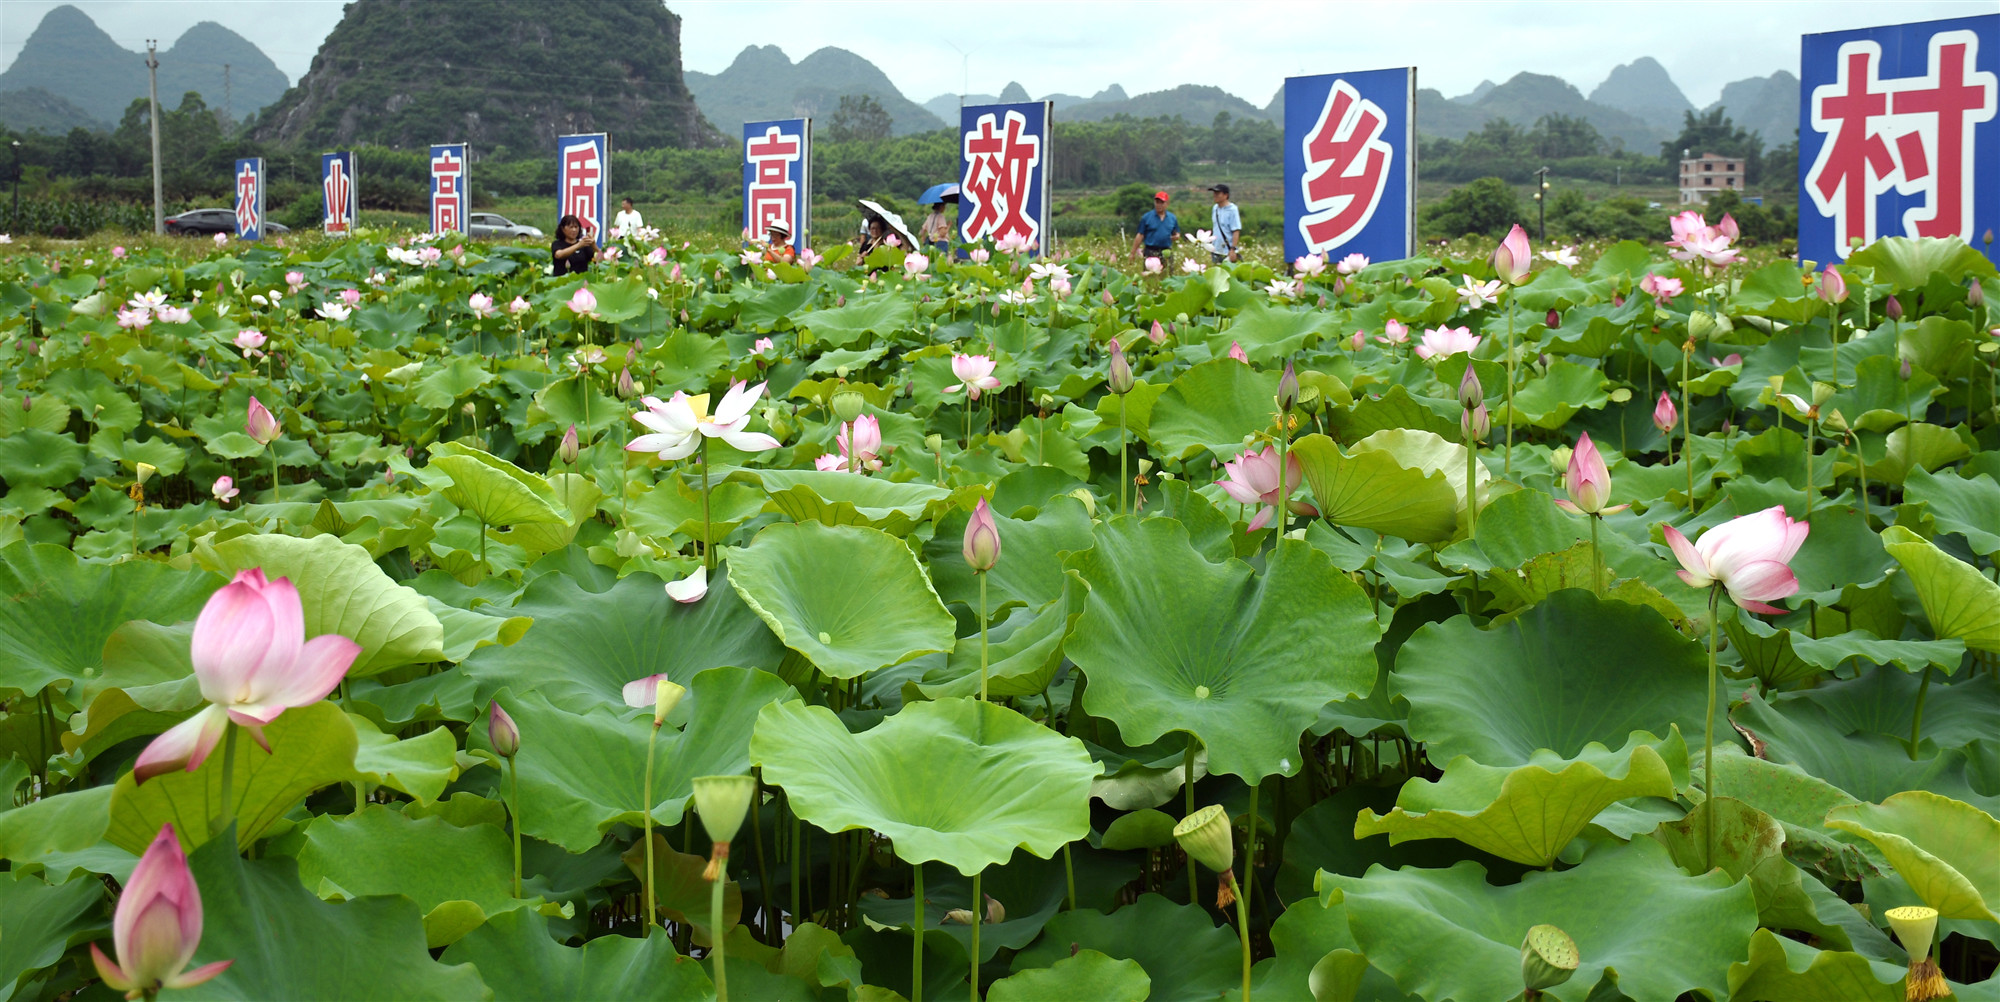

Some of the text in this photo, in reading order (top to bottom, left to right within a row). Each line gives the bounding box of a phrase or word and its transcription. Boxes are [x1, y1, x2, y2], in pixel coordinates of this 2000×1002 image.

[324, 159, 350, 234] 业
[431, 150, 462, 236] 高
[561, 140, 601, 243] 质
[747, 126, 799, 243] 高
[962, 109, 1040, 244] 效
[1299, 80, 1392, 253] 乡
[1806, 31, 1998, 256] 村
[237, 163, 258, 237] 农
